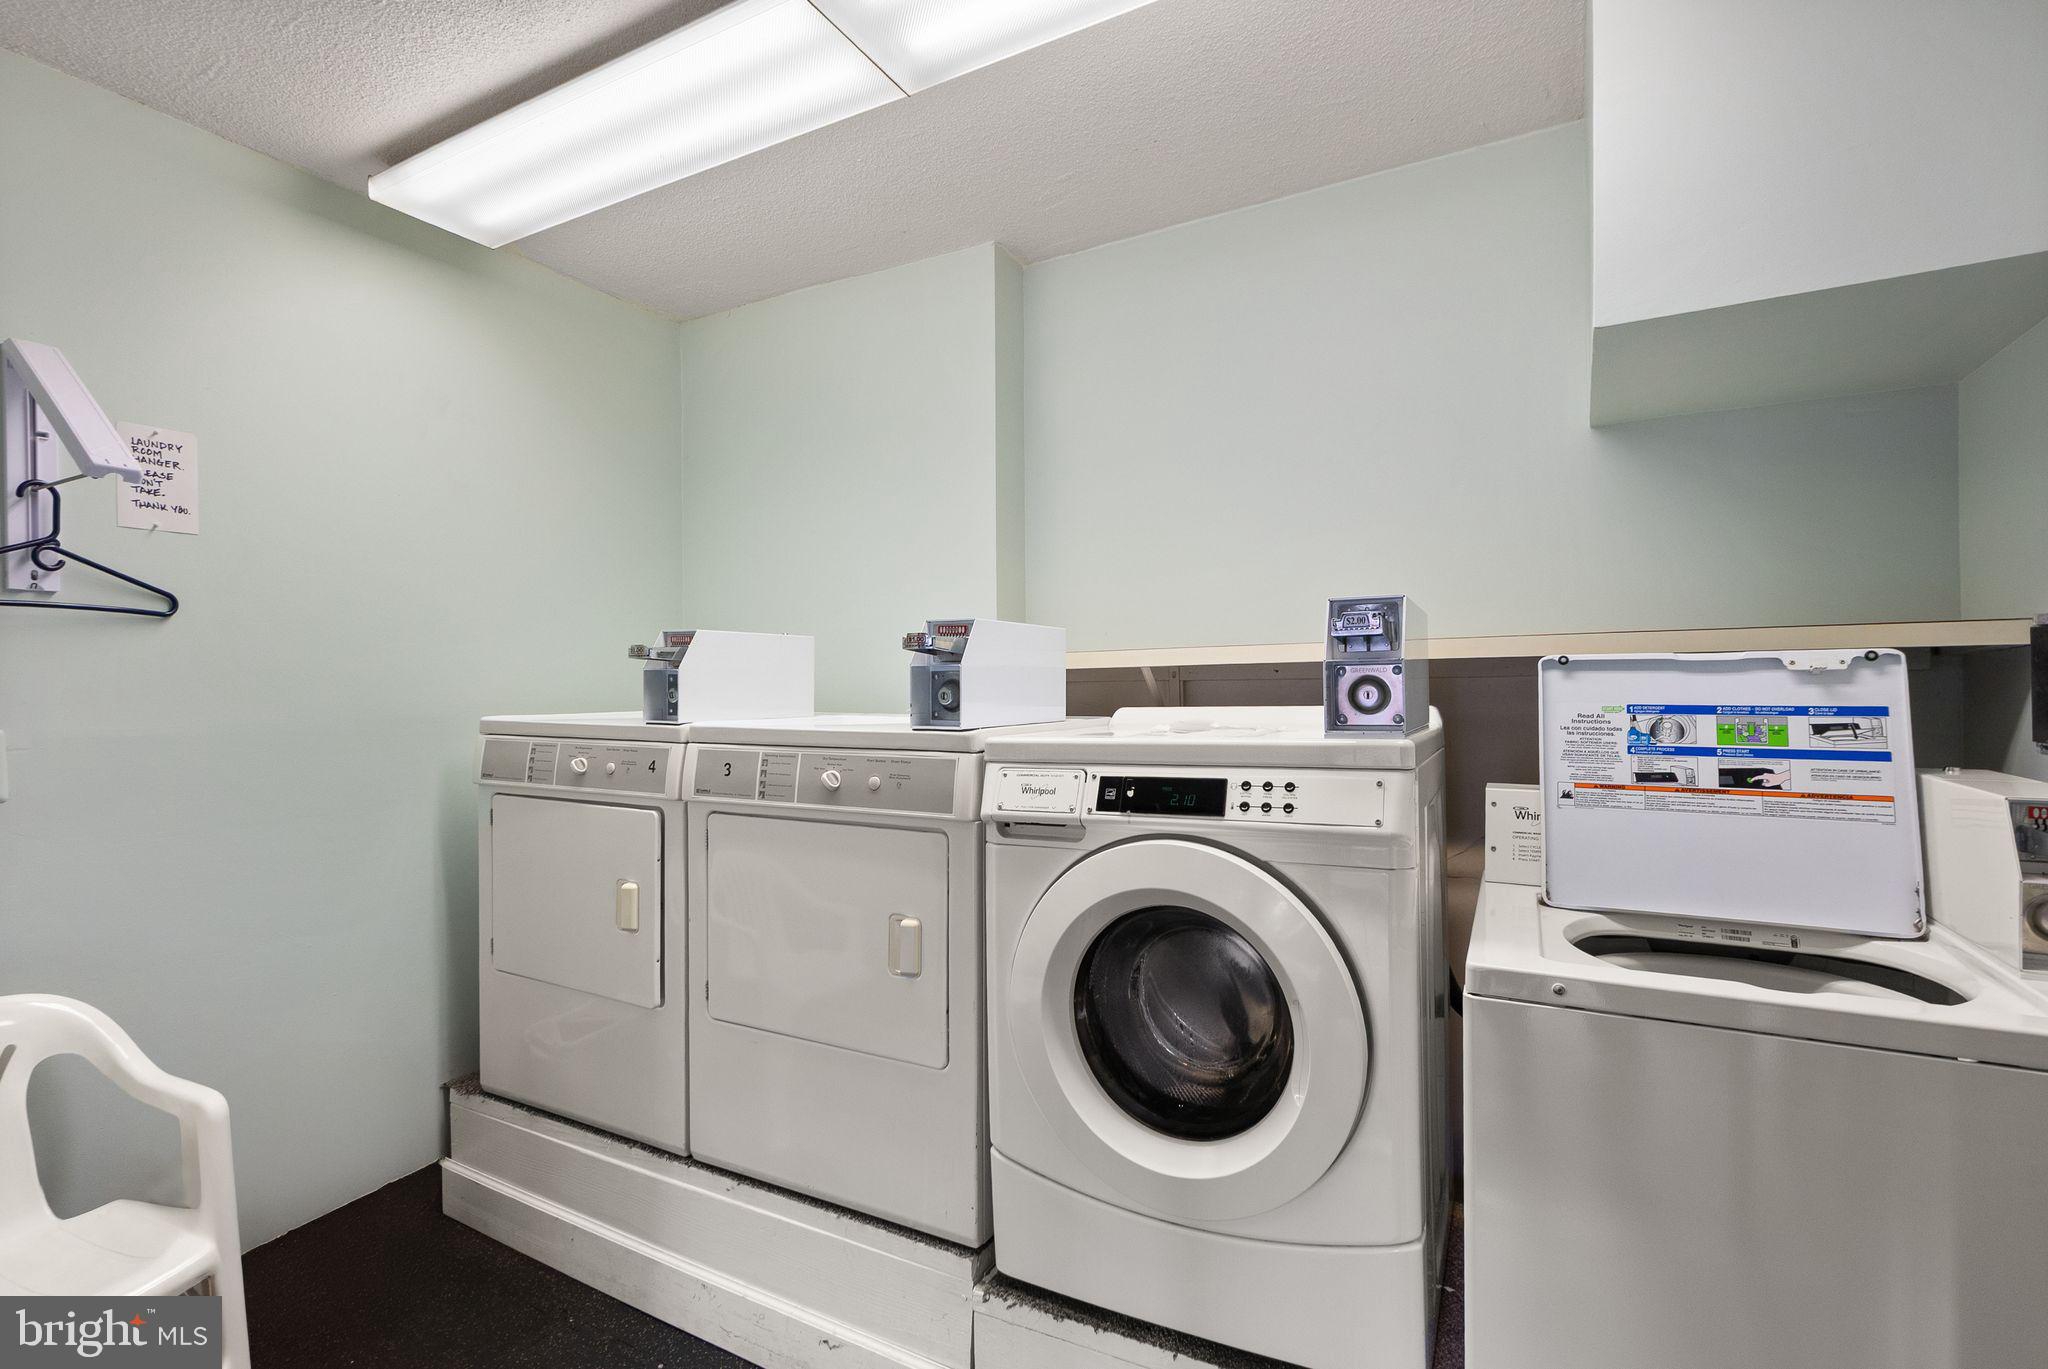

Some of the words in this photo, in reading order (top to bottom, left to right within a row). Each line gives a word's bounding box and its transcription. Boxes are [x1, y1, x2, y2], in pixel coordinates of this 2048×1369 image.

[131, 437, 183, 453] LAUNDRY
[131, 446, 163, 459] ROOM
[143, 470, 174, 481] EASE
[141, 478, 163, 487] ON'T
[130, 485, 166, 497] TAKE.
[131, 499, 168, 512] THANK
[1346, 616, 1366, 625] $2.00
[648, 760, 656, 773] 4
[723, 762, 732, 777] 3
[1022, 786, 1057, 797] Whirlpool
[1171, 793, 1197, 806] 2.10
